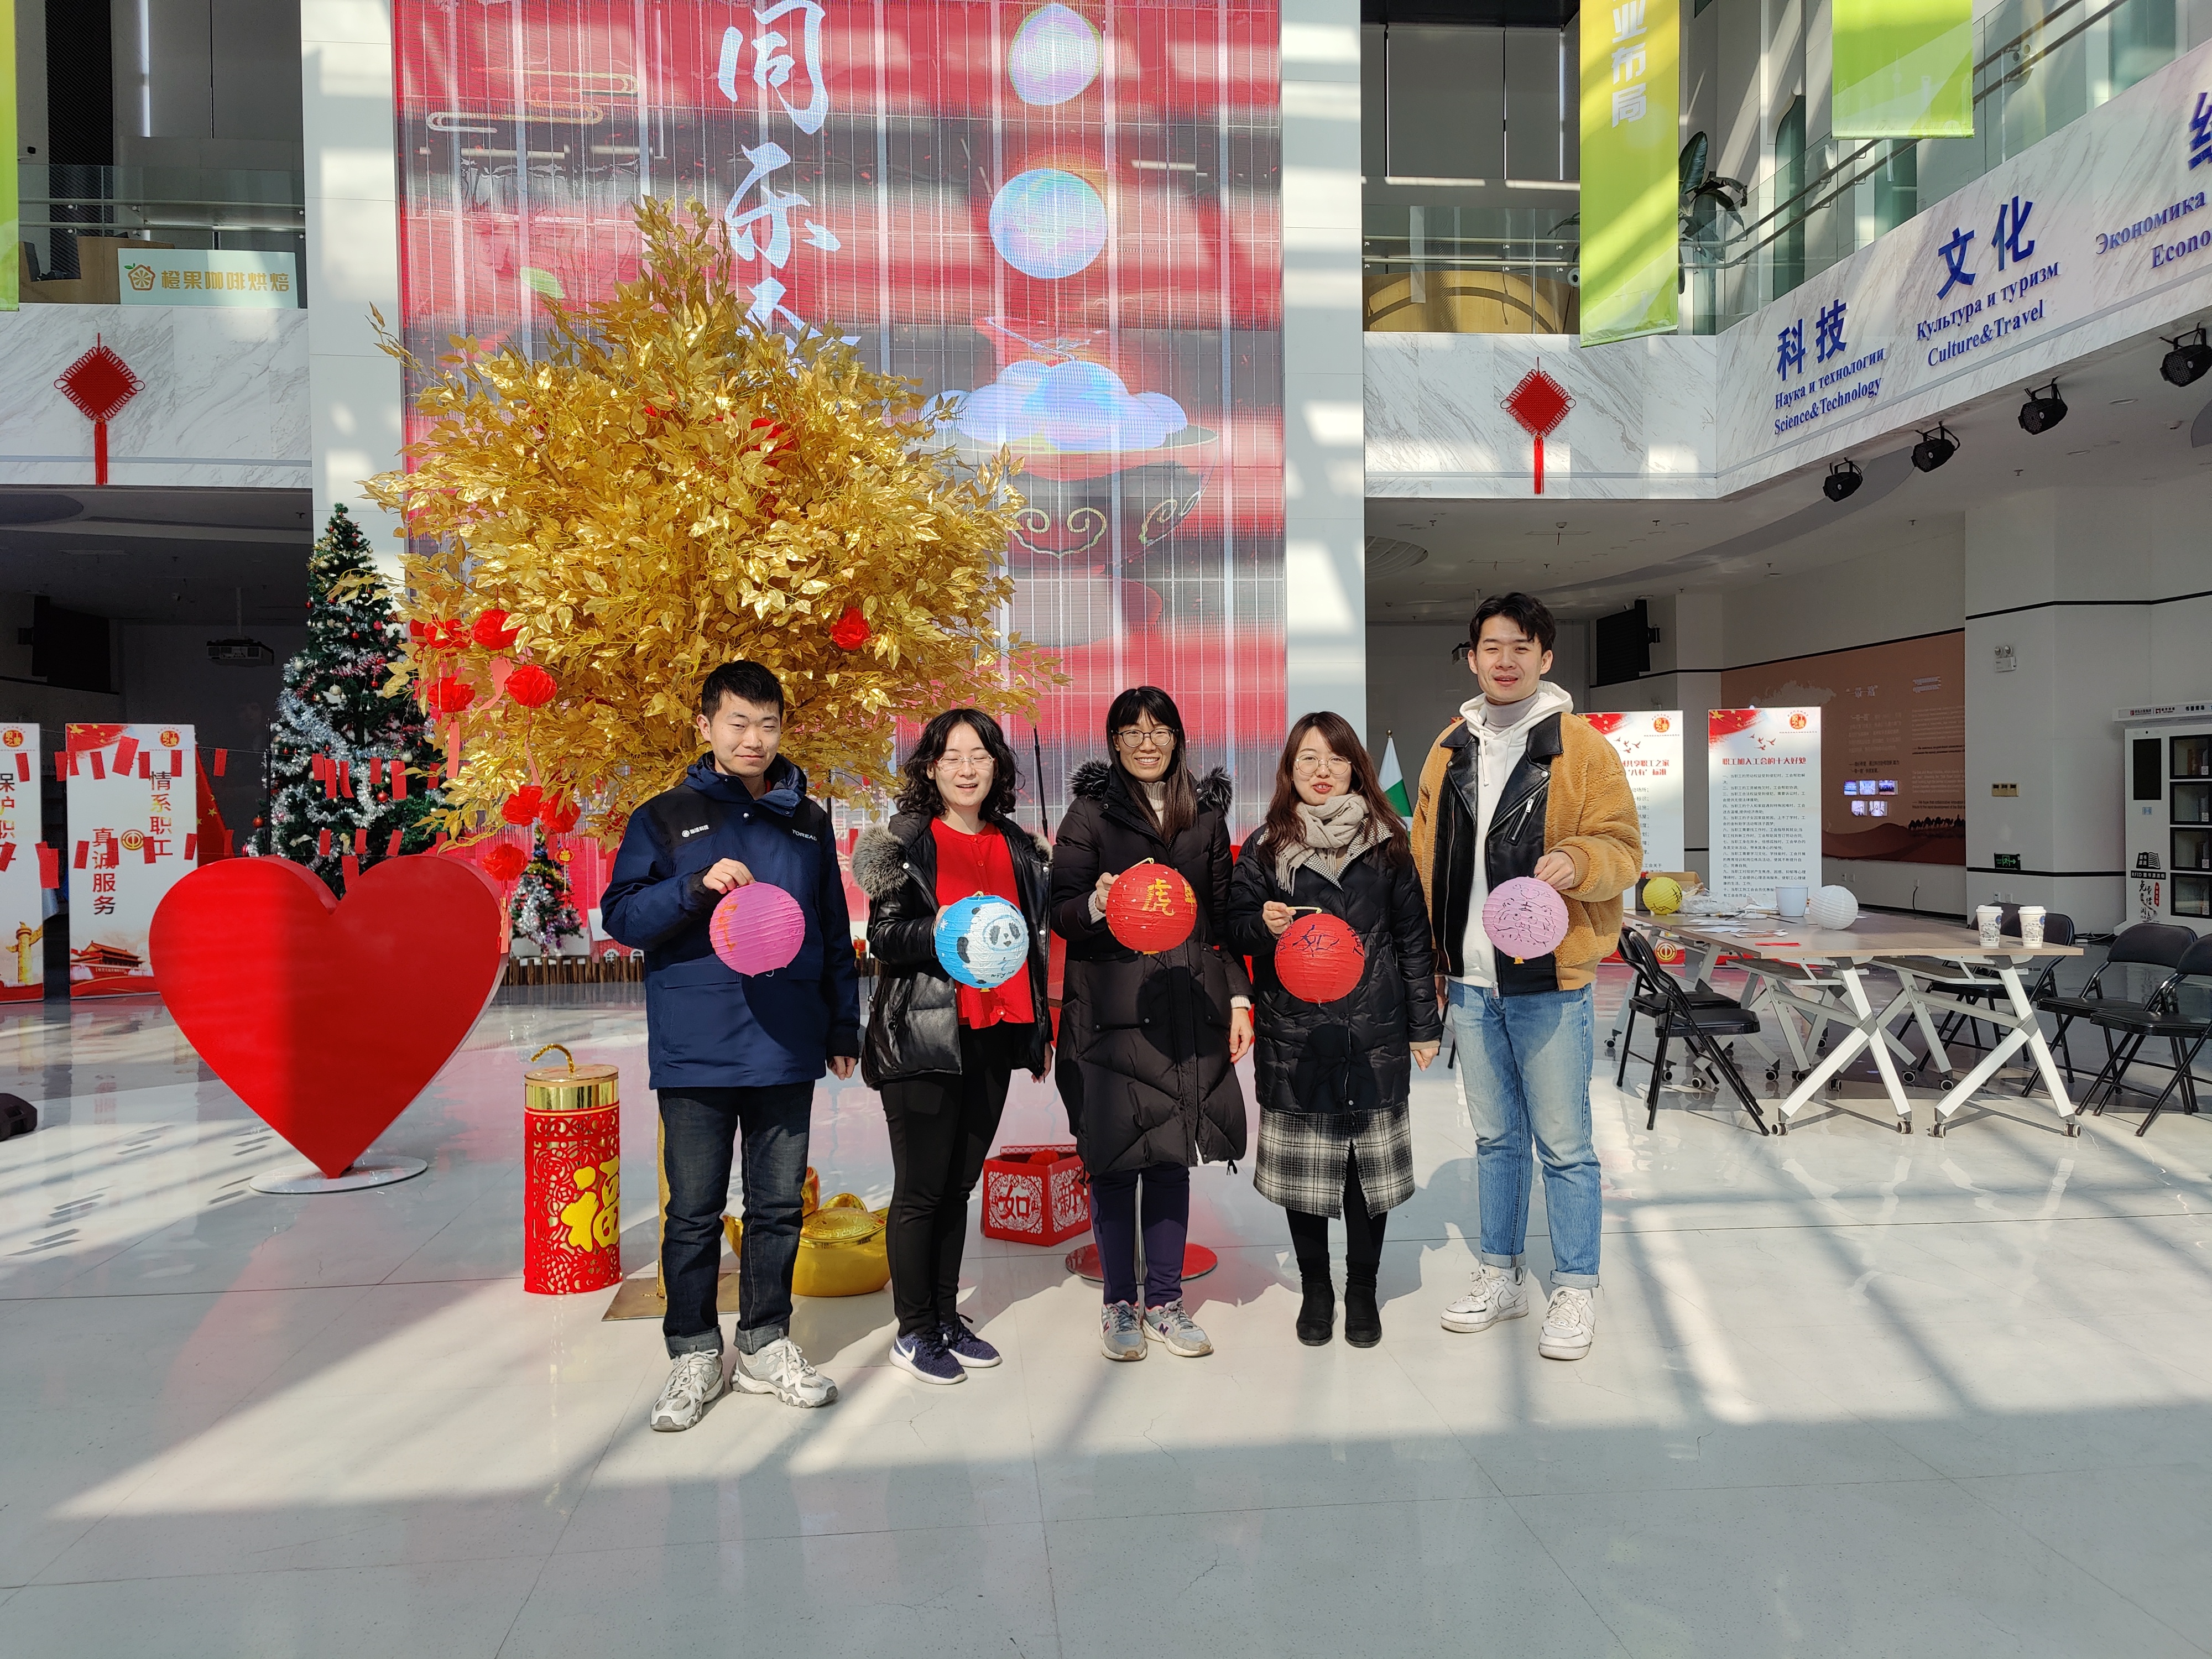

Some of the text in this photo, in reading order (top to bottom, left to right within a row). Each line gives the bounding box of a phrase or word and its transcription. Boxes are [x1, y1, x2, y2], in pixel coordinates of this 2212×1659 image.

[1937, 195, 2036, 300] 文化
[2095, 191, 2206, 255] Экономика
[161, 270, 289, 293] 橙果咖啡烘焙
[1917, 262, 2059, 341] Культура и туризм
[1776, 299, 1848, 381] 科技
[1928, 299, 2044, 367] Culture&Travel
[1774, 377, 1882, 435] Science&Technology
[1775, 348, 1885, 410] Наука и технологии
[149, 771, 173, 856] 情系职工
[792, 829, 817, 841] TOREAD
[560, 1155, 620, 1253] 福
